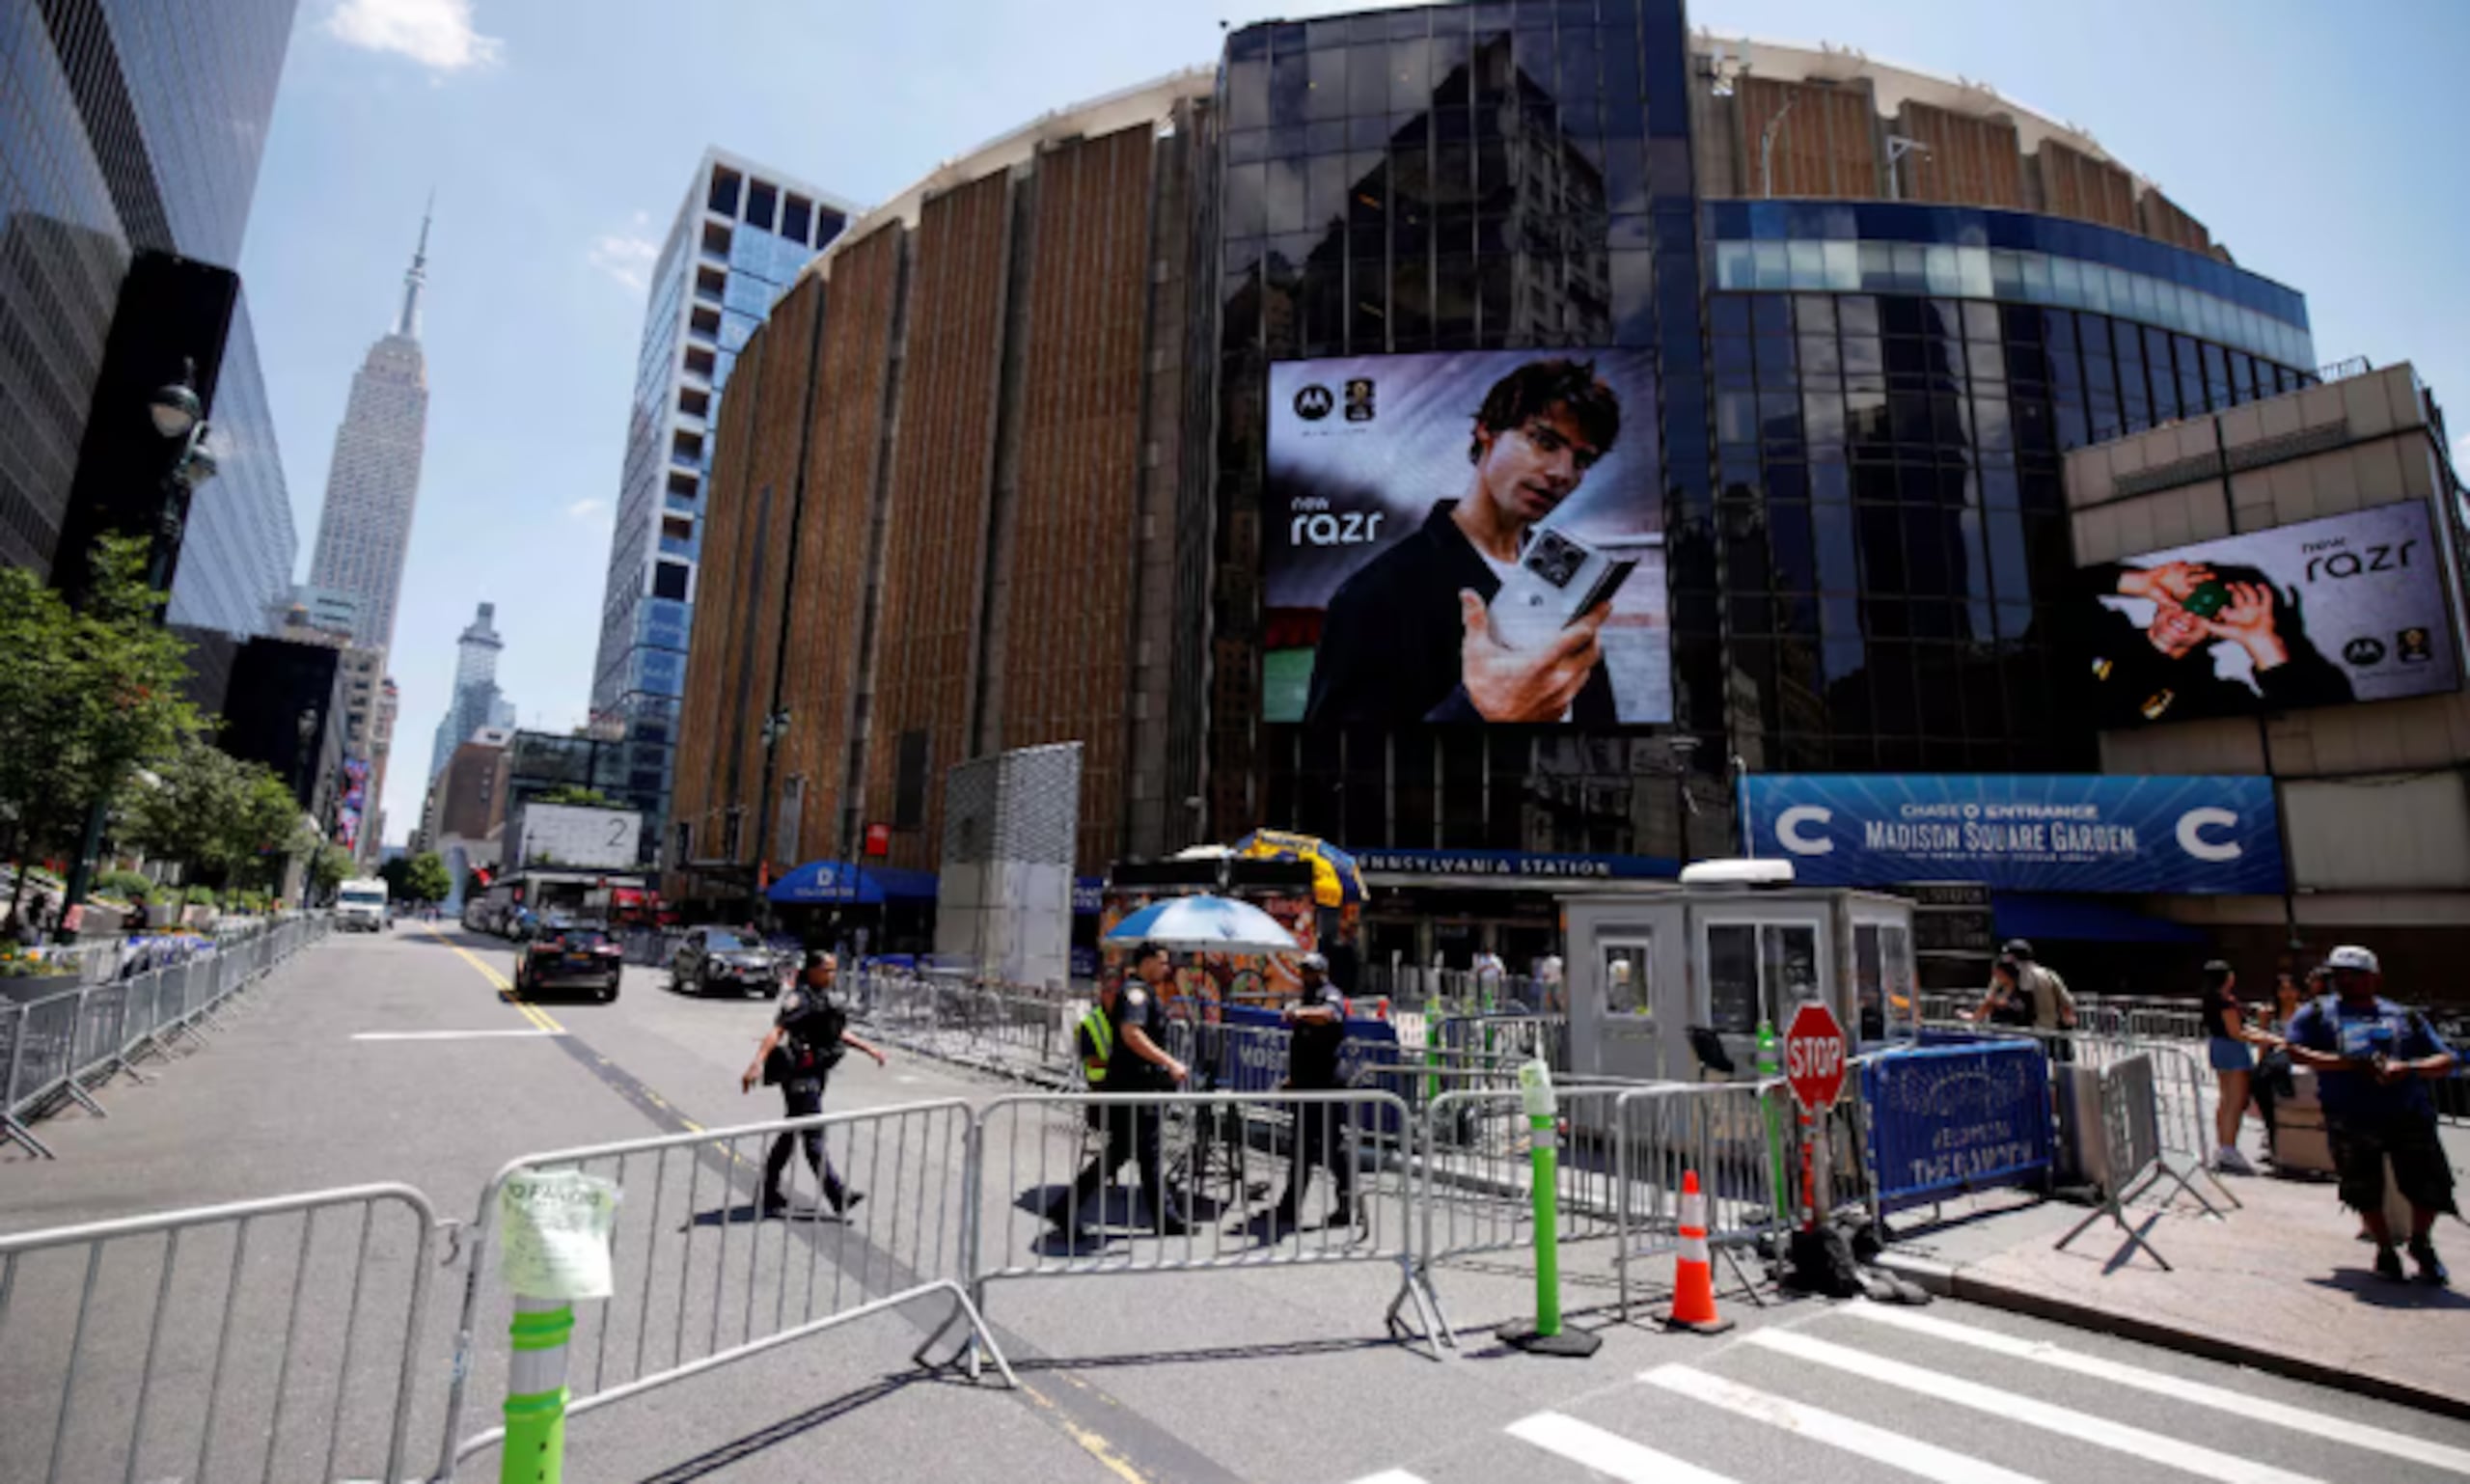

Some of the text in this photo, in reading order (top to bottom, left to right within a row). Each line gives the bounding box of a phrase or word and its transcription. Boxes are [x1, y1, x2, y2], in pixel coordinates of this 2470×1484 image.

[1290, 496, 1330, 511] new
[1290, 511, 1384, 546] razr
[2305, 540, 2417, 584] razr
[1900, 804, 2099, 819] CHASE ENTRANCE
[606, 817, 628, 847] 2
[1775, 805, 1833, 856] C
[1865, 819, 2138, 853] MADISON SQUARE GARDEN
[2175, 807, 2242, 863] C
[1520, 859, 1612, 875] STATION
[1790, 1036, 1840, 1079] STOP
